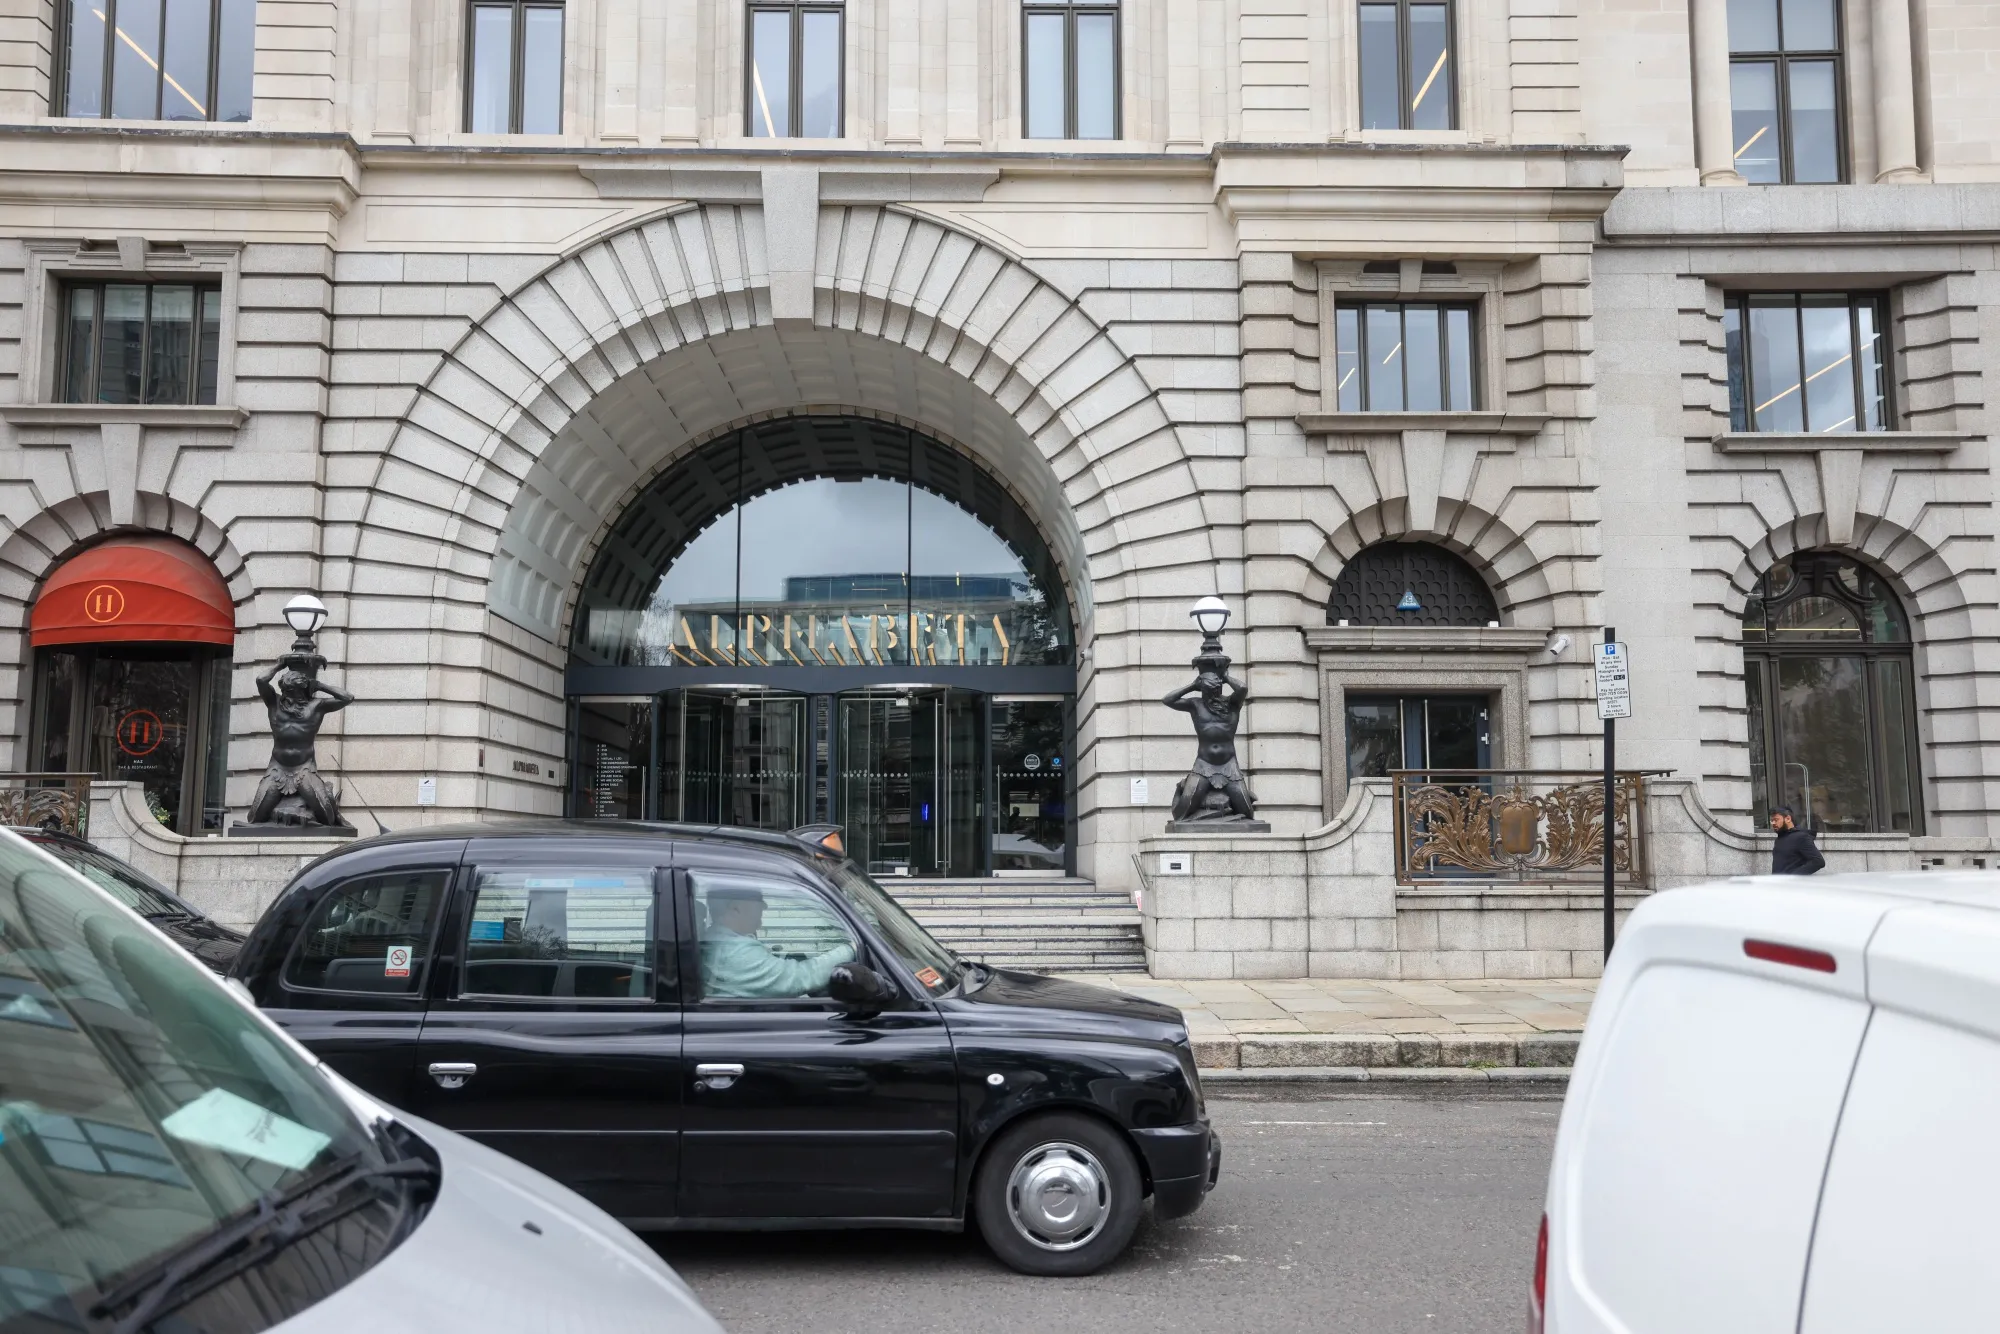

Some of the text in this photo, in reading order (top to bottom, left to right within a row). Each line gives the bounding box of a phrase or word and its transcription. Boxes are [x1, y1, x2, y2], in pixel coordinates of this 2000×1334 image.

[95, 594, 113, 613] H
[667, 612, 1010, 662] ALPHABETA
[1607, 645, 1614, 654] P
[129, 721, 150, 744] H
